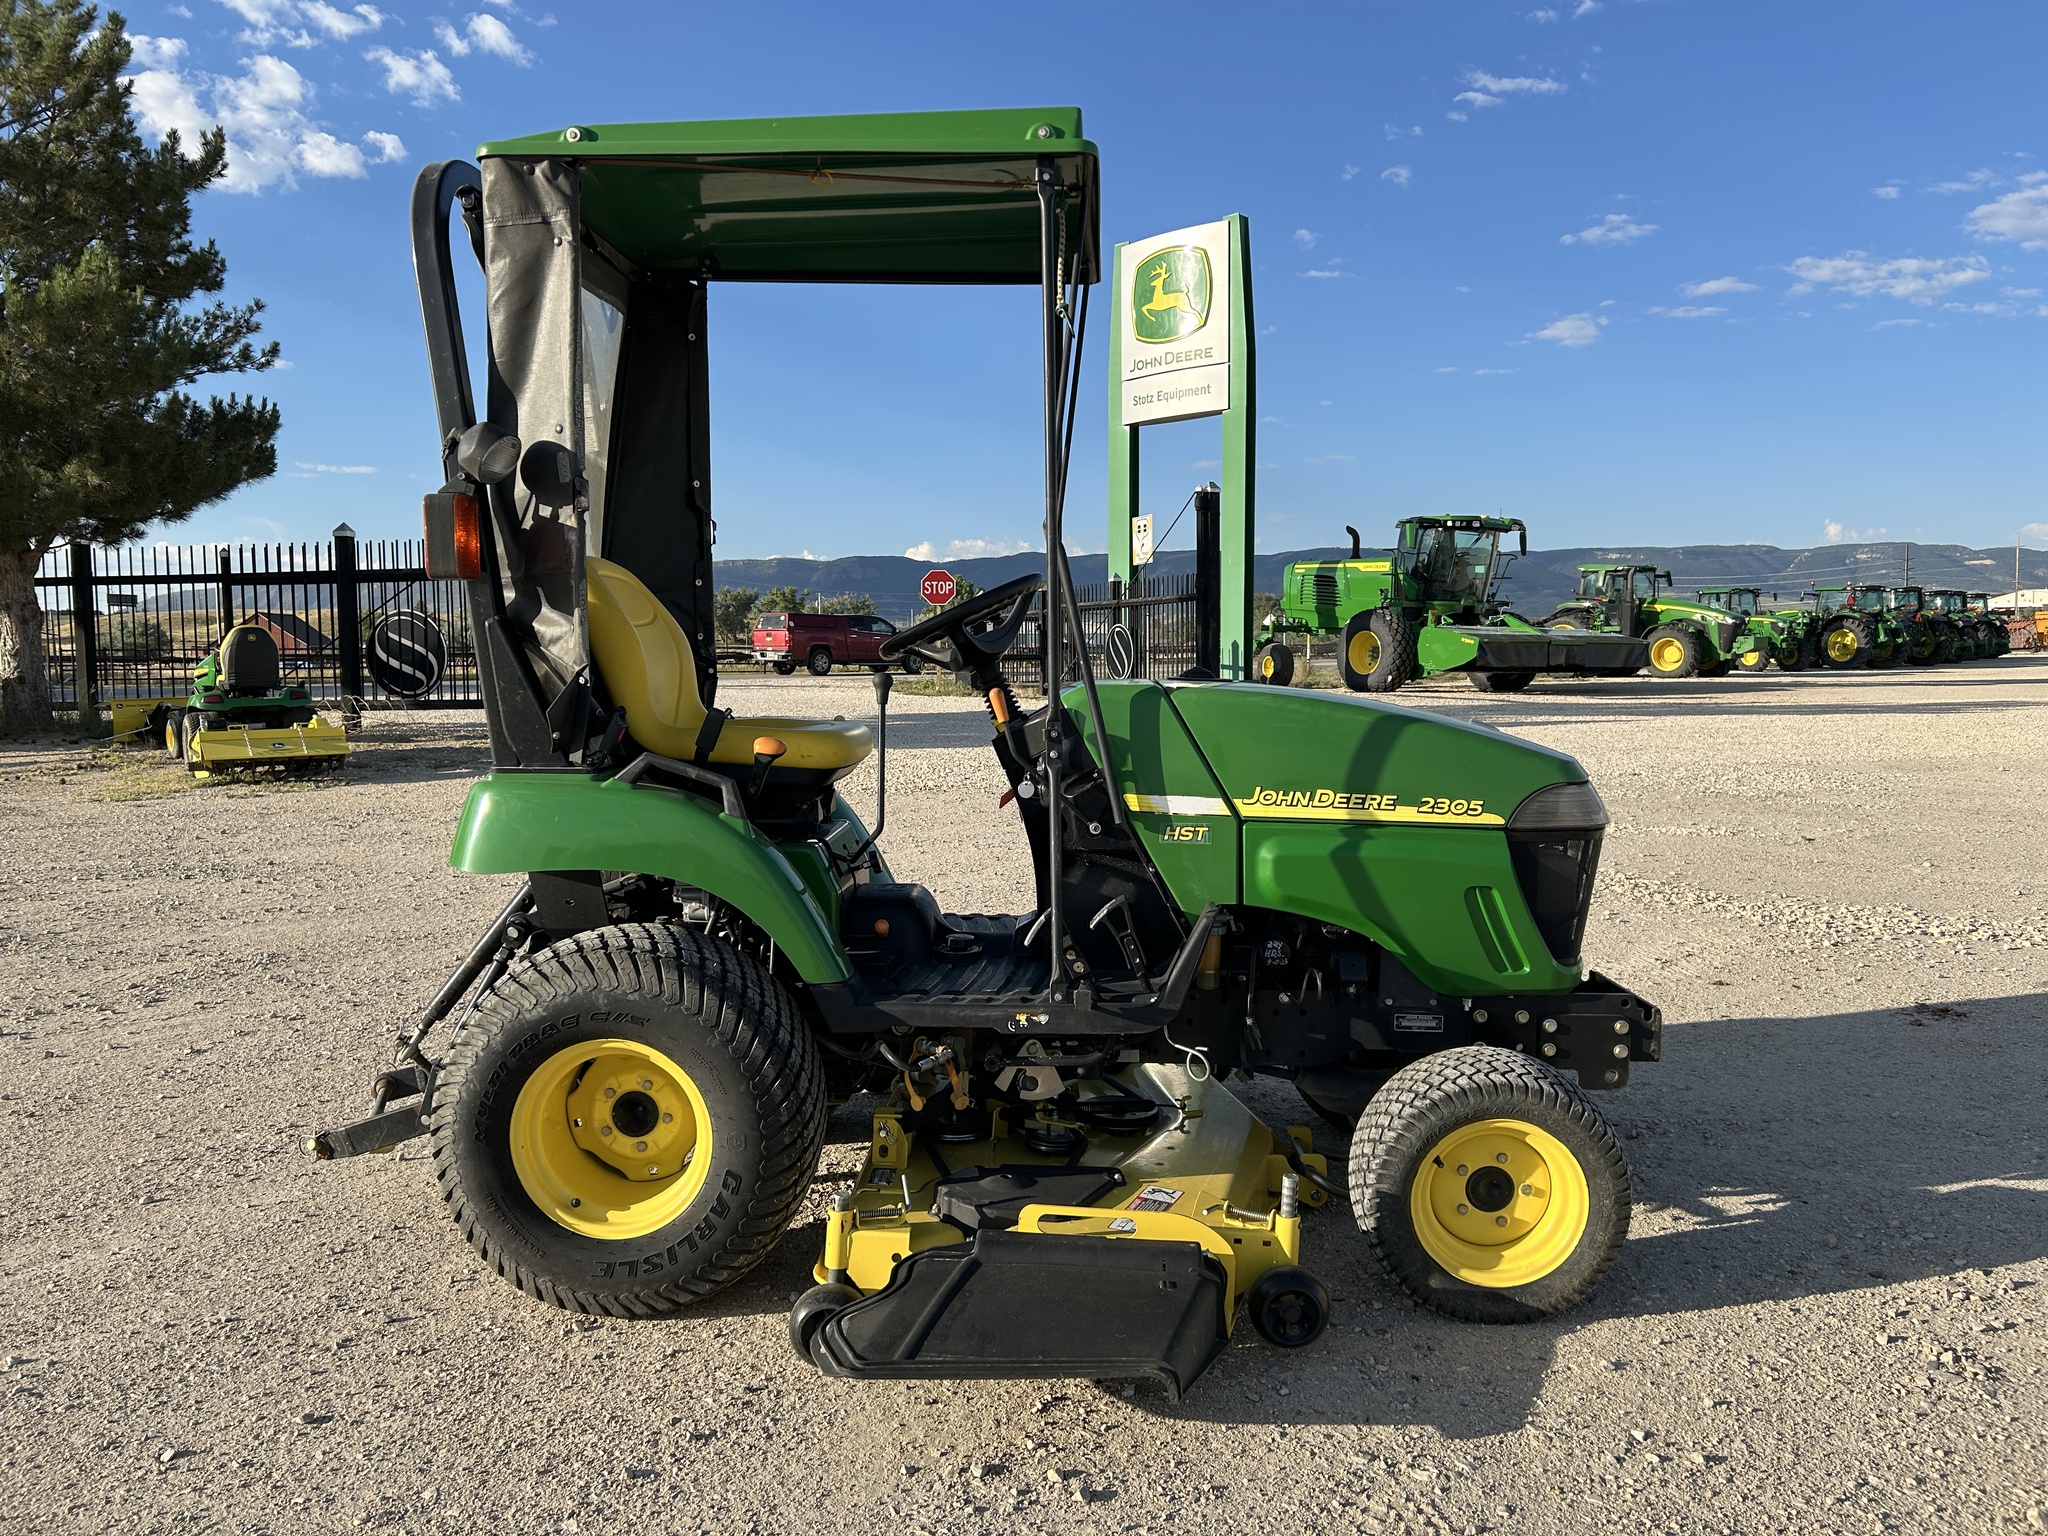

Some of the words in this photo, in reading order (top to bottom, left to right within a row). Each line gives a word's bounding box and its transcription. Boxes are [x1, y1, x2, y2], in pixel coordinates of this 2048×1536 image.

[1130, 356, 1162, 373] JOHN
[1165, 347, 1213, 365] DEERE
[1133, 393, 1154, 407] Stotz
[1157, 383, 1211, 403] Equipment
[924, 581, 953, 595] STOP
[1242, 786, 1312, 808] JOHN
[1312, 788, 1398, 812] DEERE
[1417, 797, 1484, 816] 2305
[1163, 826, 1209, 841] HST
[474, 1061, 507, 1145] MULTI
[507, 1013, 581, 1061] TRAC
[591, 1168, 742, 1279] CARLISLE
